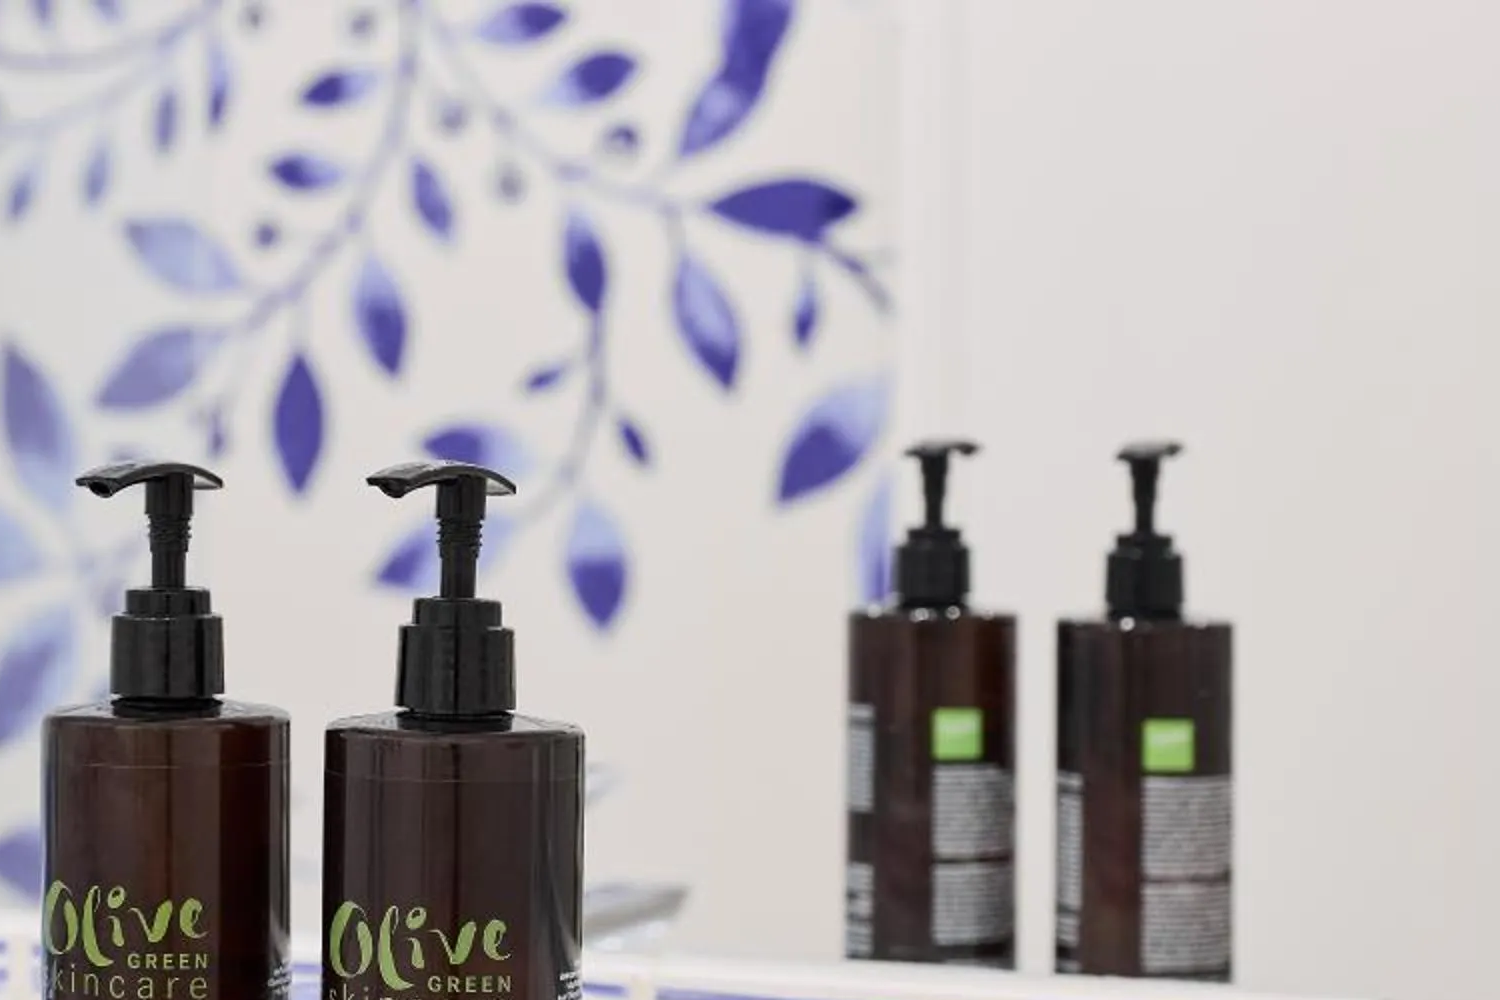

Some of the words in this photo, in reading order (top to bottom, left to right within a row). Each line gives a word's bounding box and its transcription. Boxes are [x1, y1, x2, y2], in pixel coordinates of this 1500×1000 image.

[42, 880, 209, 967] Olive
[329, 900, 512, 991] Olive
[127, 953, 209, 970] GREEN
[427, 974, 512, 993] GREEN
